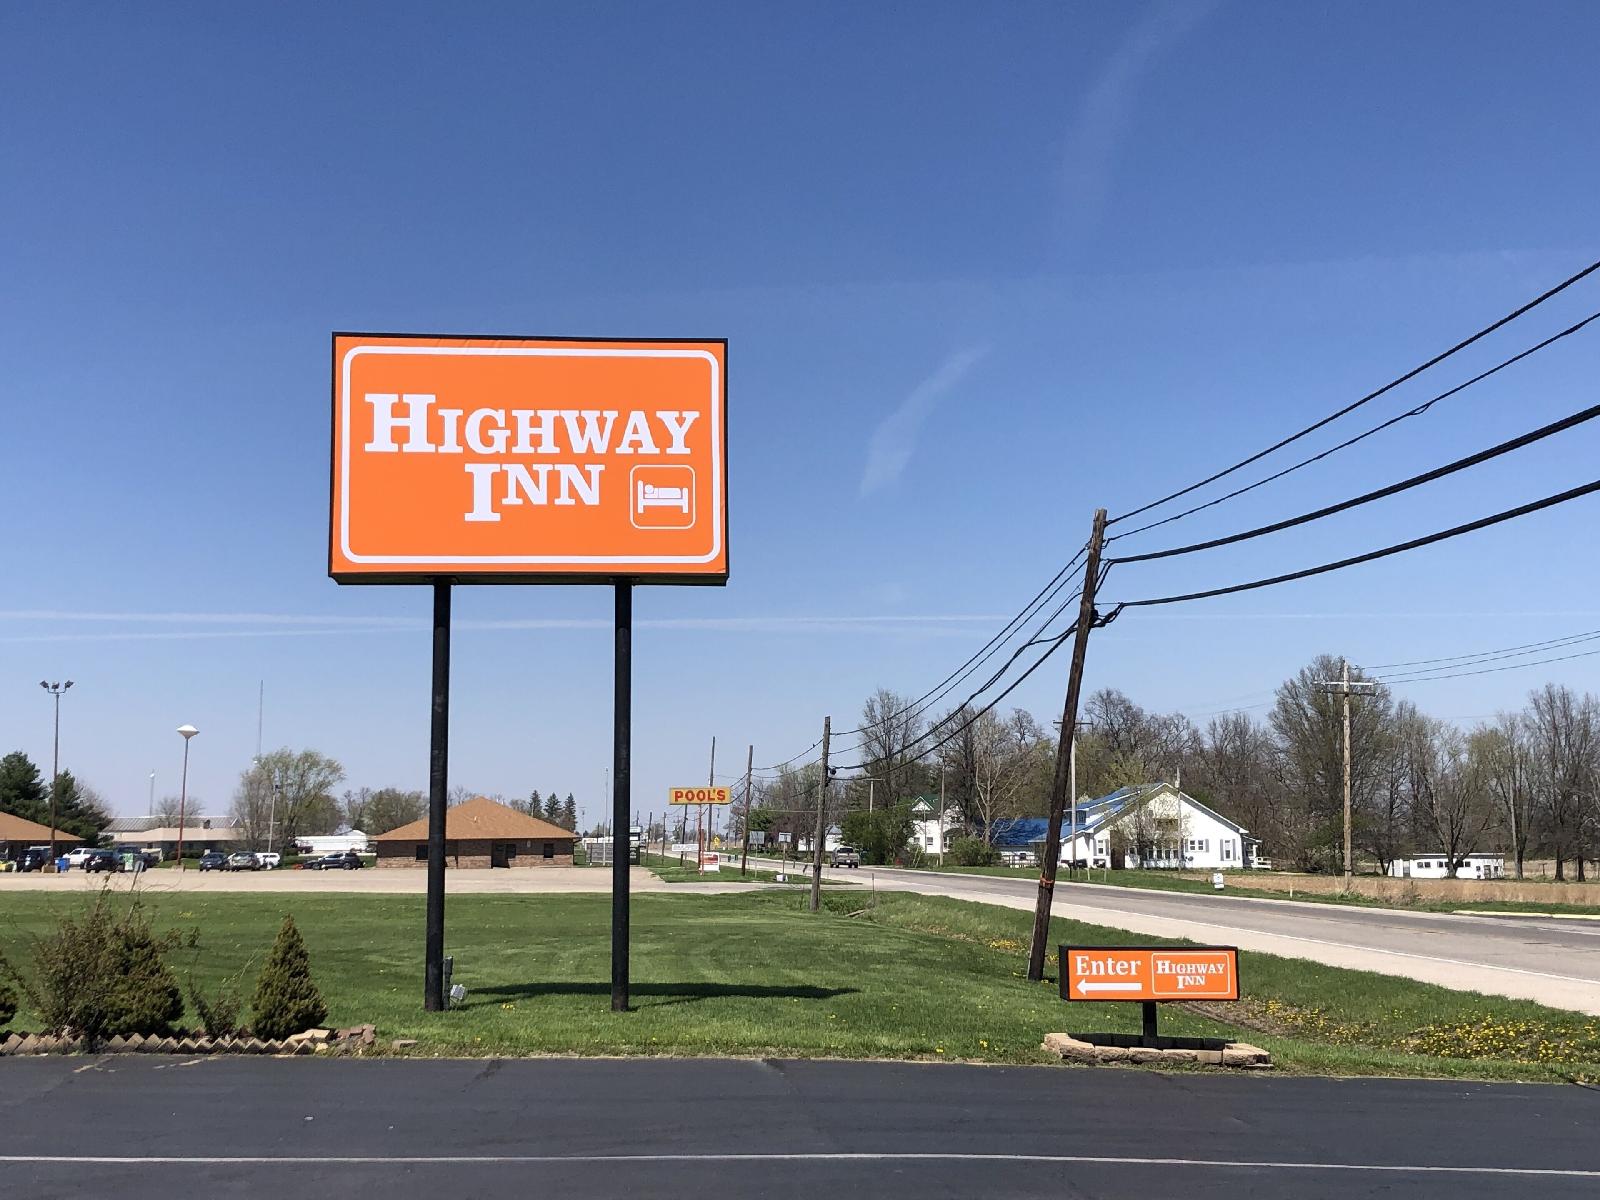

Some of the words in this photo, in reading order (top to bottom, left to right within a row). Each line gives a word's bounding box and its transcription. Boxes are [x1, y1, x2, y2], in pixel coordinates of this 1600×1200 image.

[364, 393, 700, 455] HIGHWAY
[464, 463, 606, 522] INN
[674, 789, 726, 802] POOL'S
[1075, 955, 1142, 976] Enter
[1156, 960, 1225, 974] HIGHWAY
[1177, 975, 1206, 989] INN
